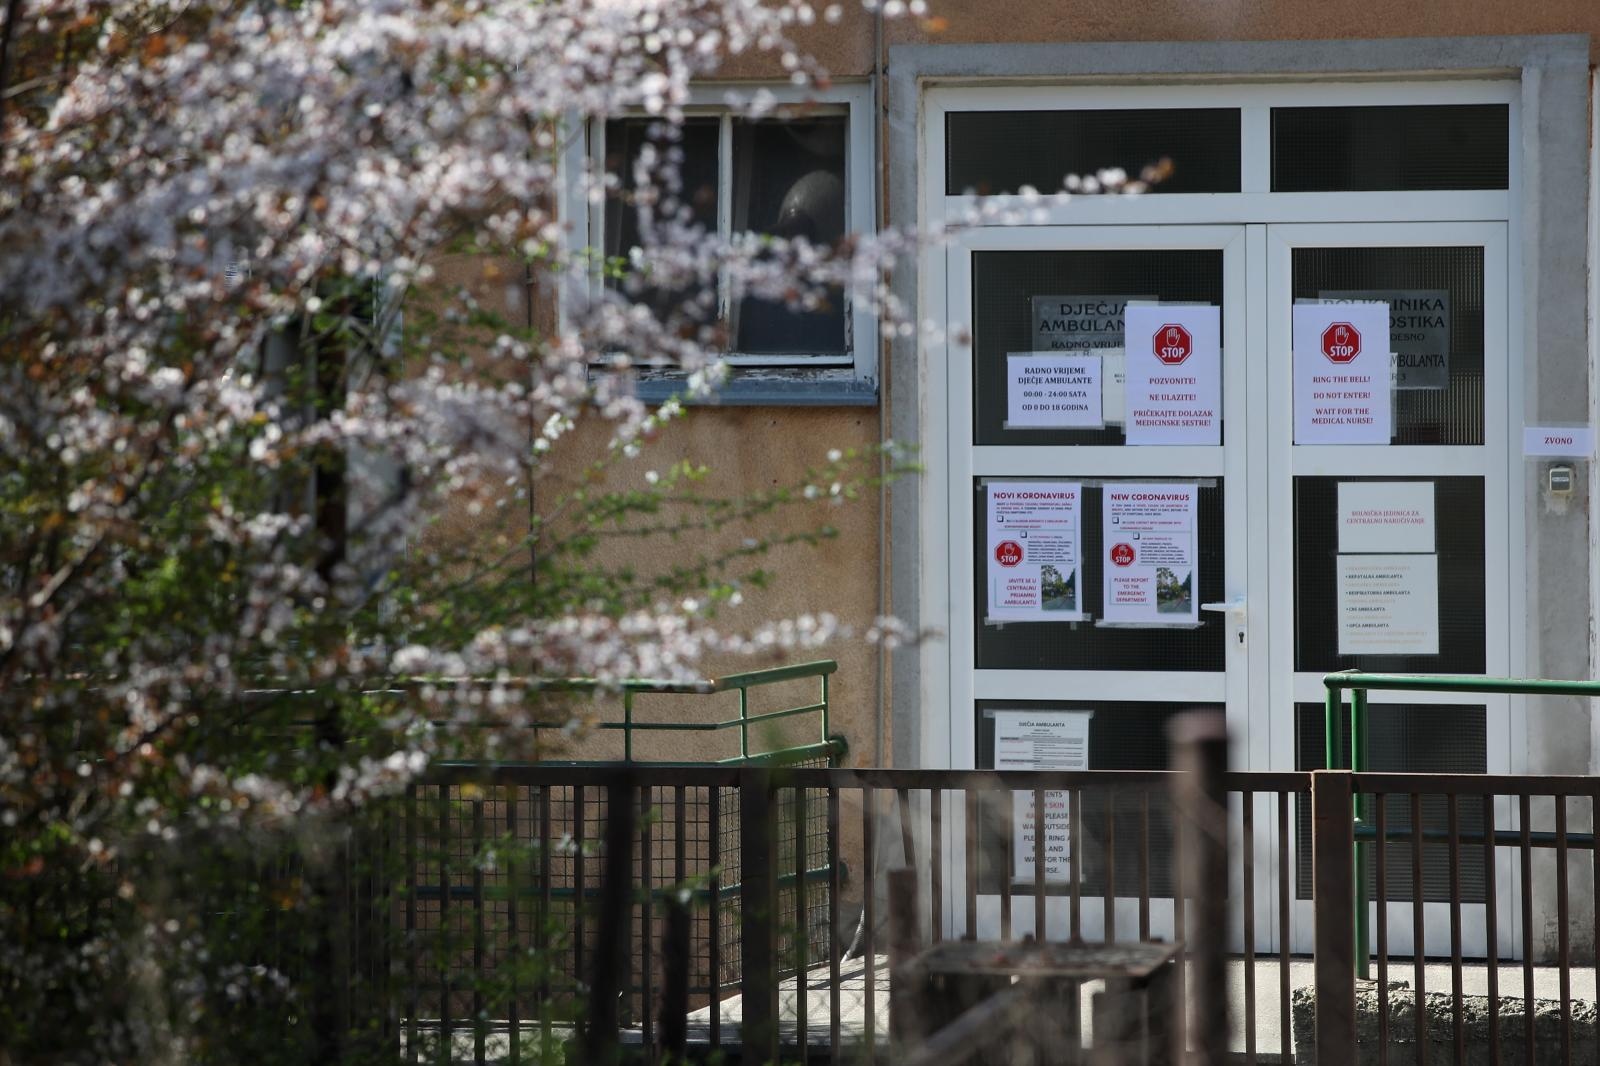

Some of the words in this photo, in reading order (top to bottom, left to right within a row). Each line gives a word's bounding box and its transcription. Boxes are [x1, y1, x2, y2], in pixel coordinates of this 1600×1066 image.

[1040, 319, 1125, 331] AMBULAN
[1391, 333, 1425, 341] DESNO
[1051, 341, 1091, 349] RADNO
[1093, 341, 1124, 349] VRIJE
[1161, 346, 1185, 359] STOP
[1330, 345, 1354, 357] STOP
[1390, 354, 1446, 367] MBULANTA
[1024, 367, 1052, 375] RADNO
[1053, 367, 1086, 376] VRIJEME
[1018, 375, 1043, 385] DJEČJE
[1149, 377, 1196, 385] POZVONITE!
[1133, 409, 1177, 418] PRIČEKAJTE
[1135, 419, 1180, 427] MEDICINSKE
[1181, 419, 1211, 427] SESTRE!
[1544, 437, 1573, 445] ZVONO
[1131, 493, 1190, 501] CORONAVIRUS
[1001, 555, 1018, 563] STOP
